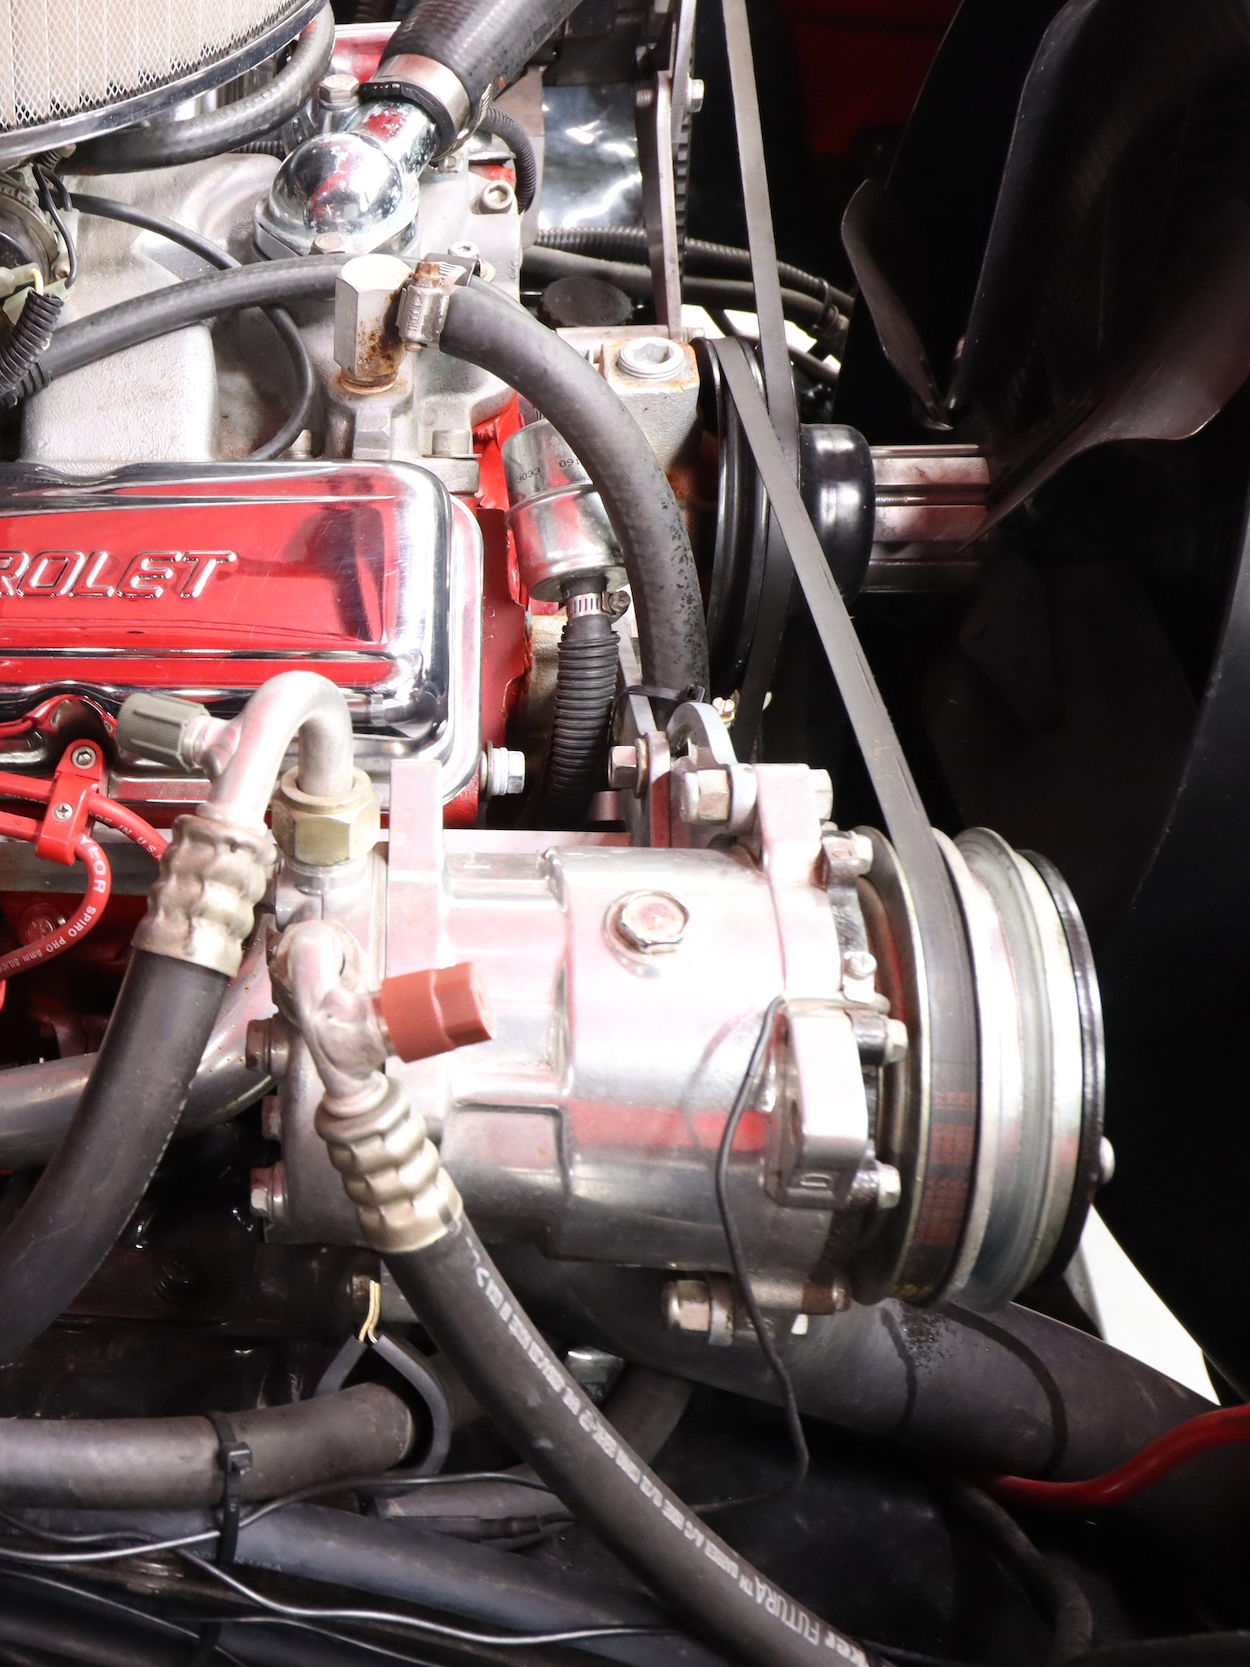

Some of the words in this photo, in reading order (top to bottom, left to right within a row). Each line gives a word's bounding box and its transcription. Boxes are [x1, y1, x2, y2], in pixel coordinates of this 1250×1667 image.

[80, 834, 107, 893] YLOR
[67, 906, 97, 937] SPIRO
[22, 949, 44, 962] 8mm
[45, 936, 67, 953] PRO
